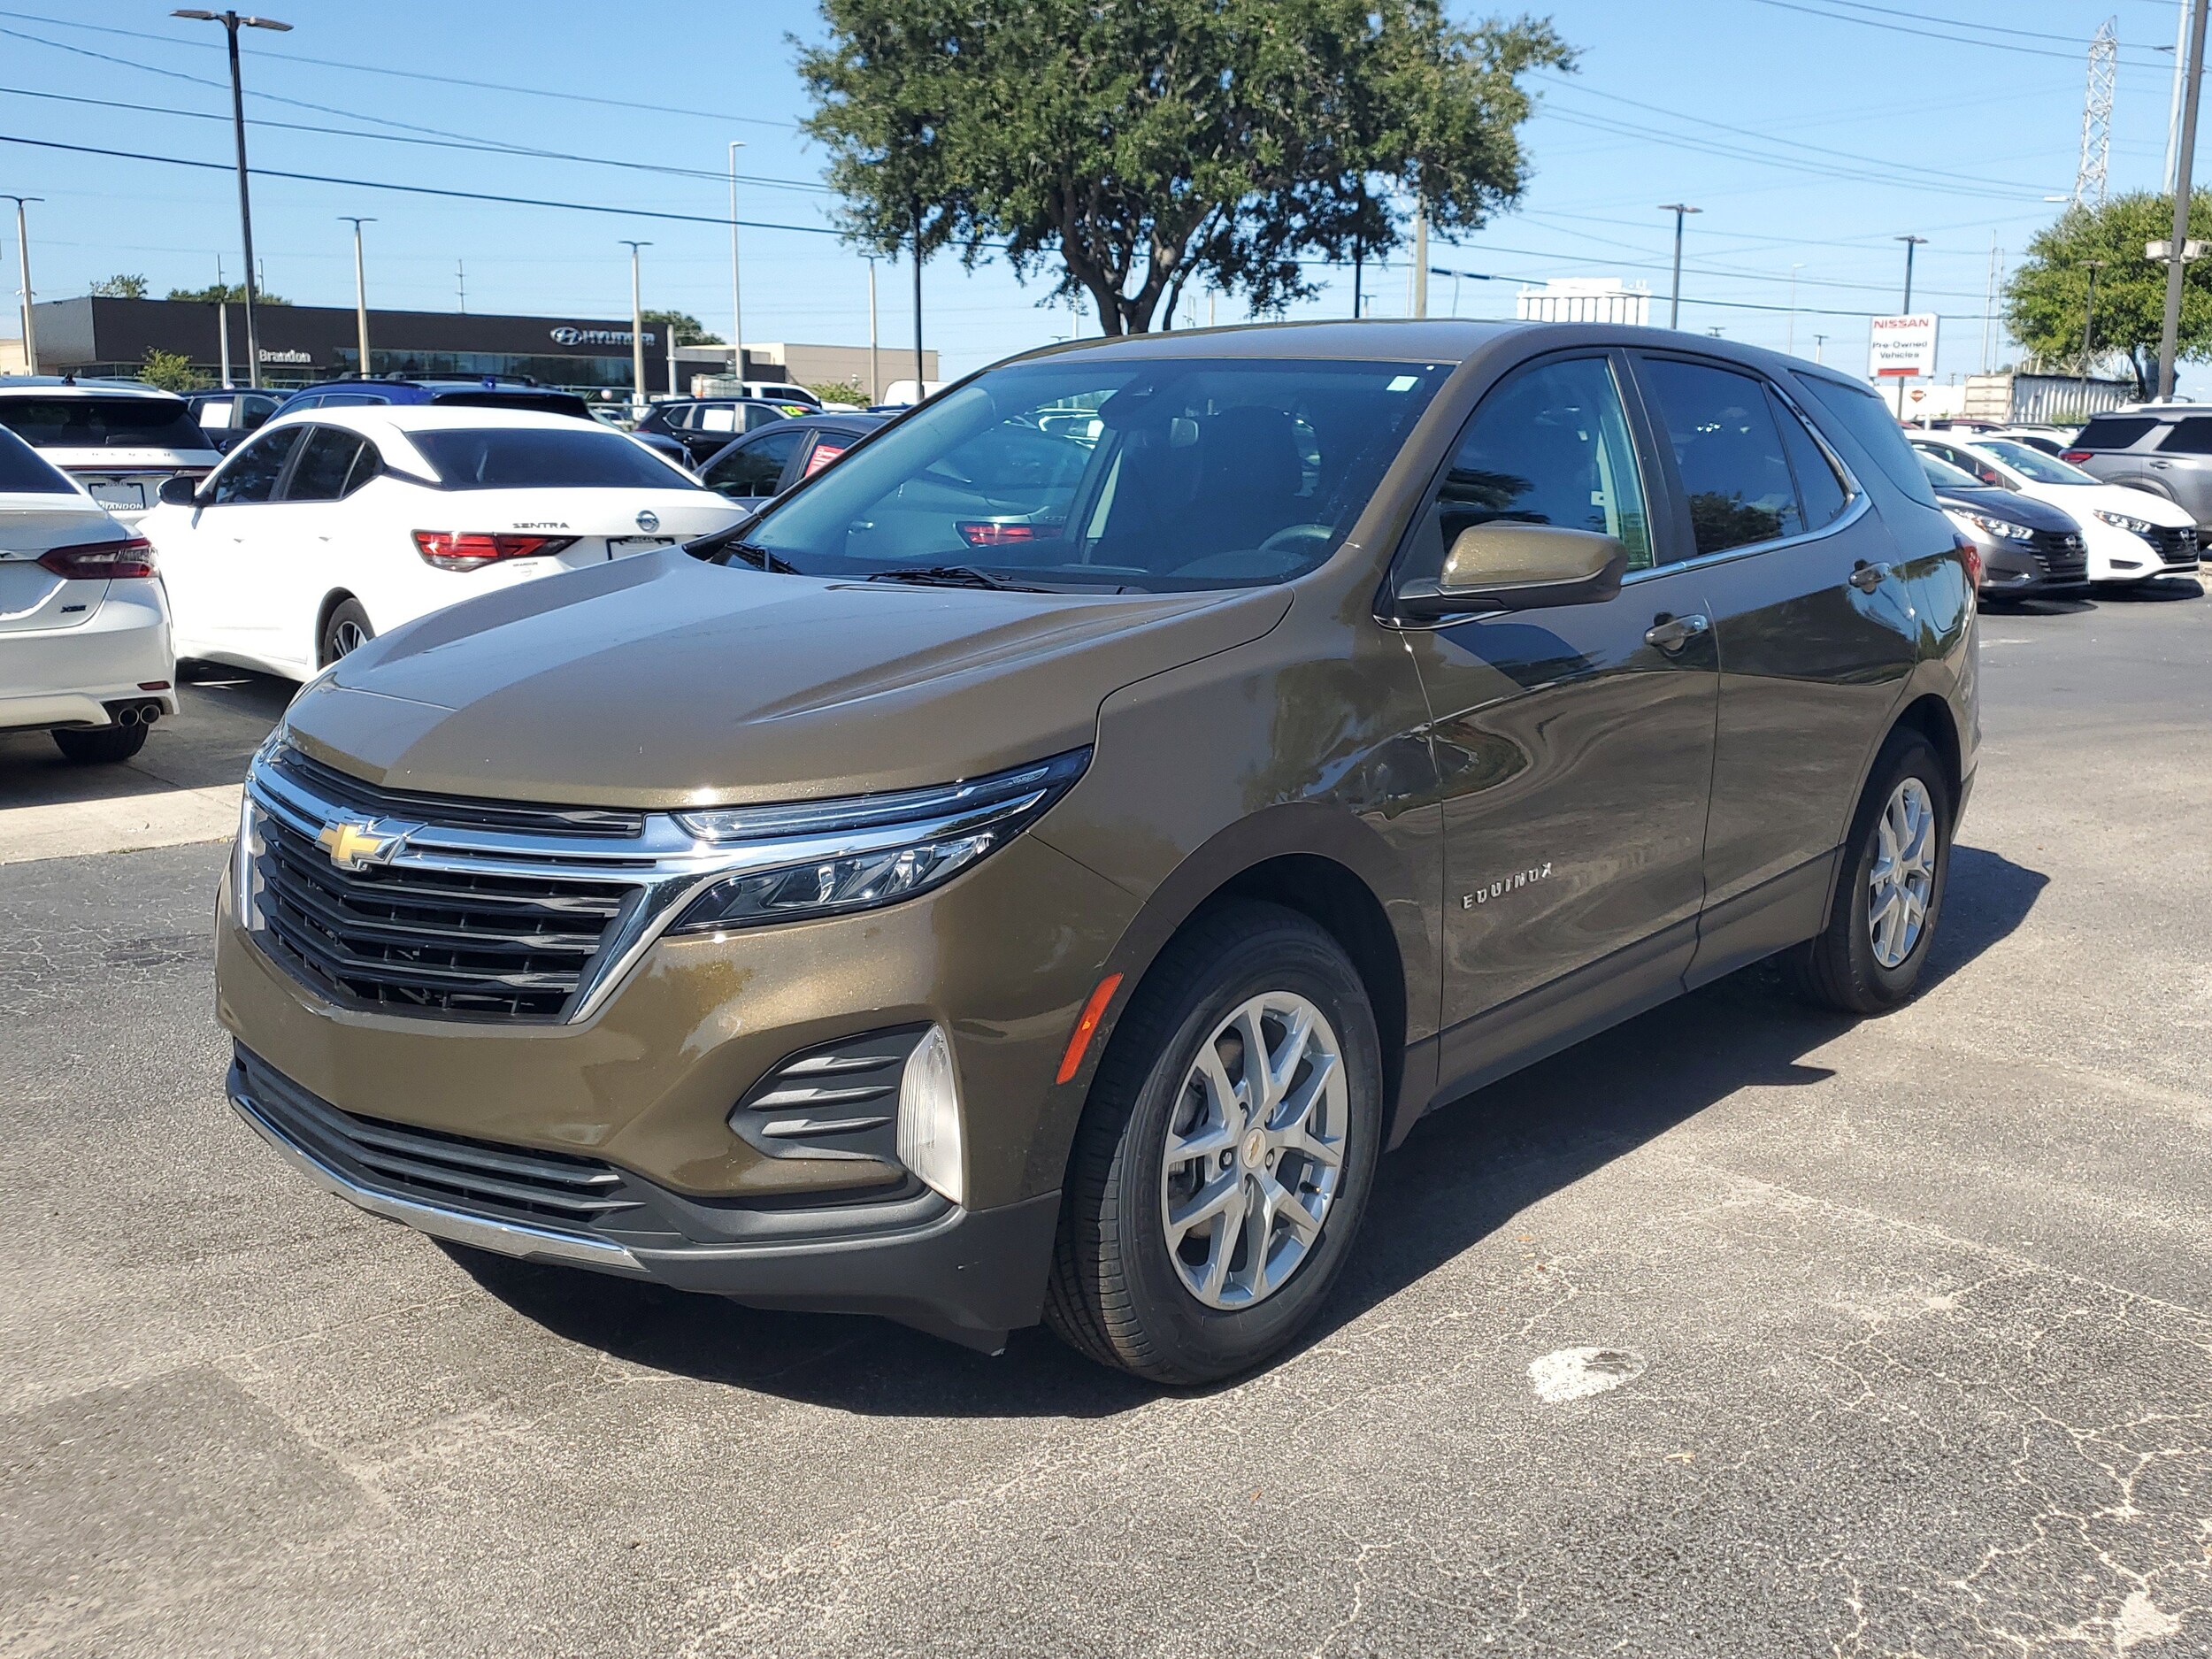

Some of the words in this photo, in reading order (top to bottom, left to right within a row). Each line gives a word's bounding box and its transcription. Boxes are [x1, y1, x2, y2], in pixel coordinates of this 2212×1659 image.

[1874, 319, 1929, 328] NISSAN
[259, 349, 311, 363] Brandon
[1463, 862, 1552, 909] EQUINOX
